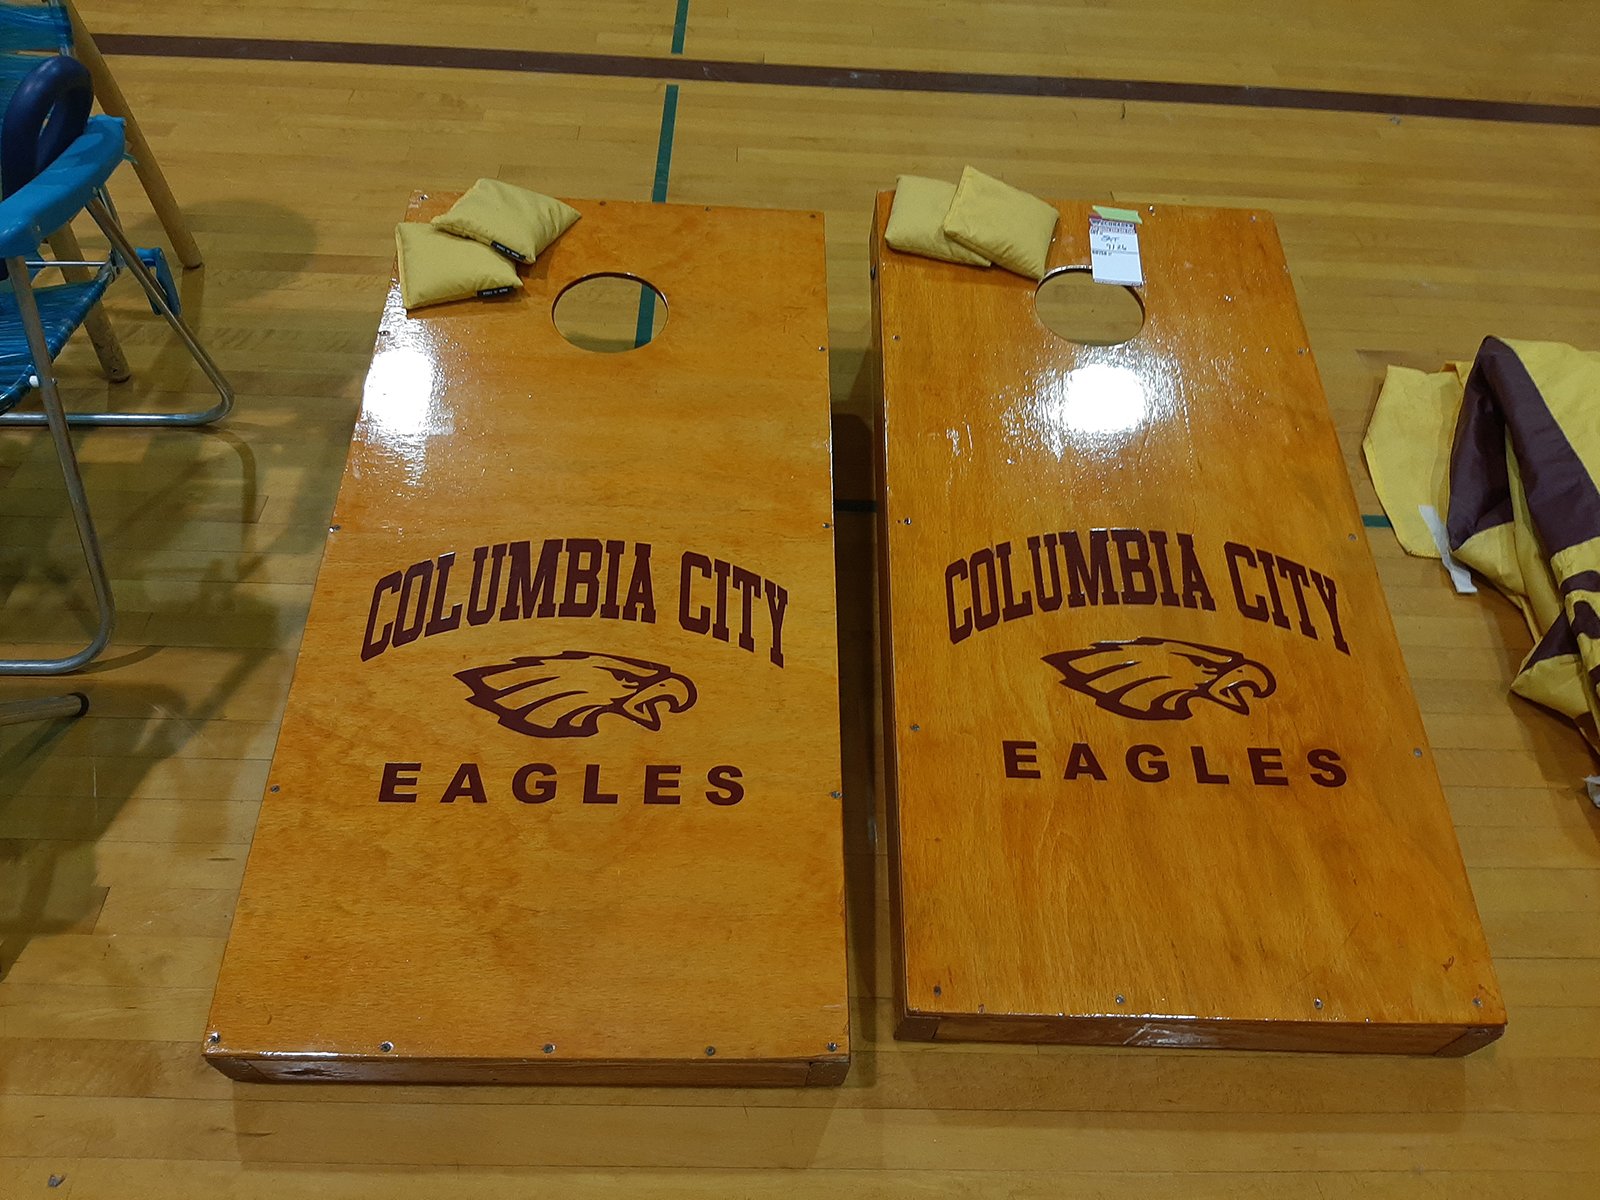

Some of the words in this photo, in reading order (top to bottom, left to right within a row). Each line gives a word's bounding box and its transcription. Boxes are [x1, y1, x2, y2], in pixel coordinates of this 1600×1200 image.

[360, 538, 657, 662] COLUMBIA
[678, 551, 788, 669] CITY
[945, 527, 1217, 645] COLUMBIA
[1224, 541, 1350, 656] CITY
[378, 763, 745, 805] EAGLES
[1002, 741, 1347, 787] EAGLES
